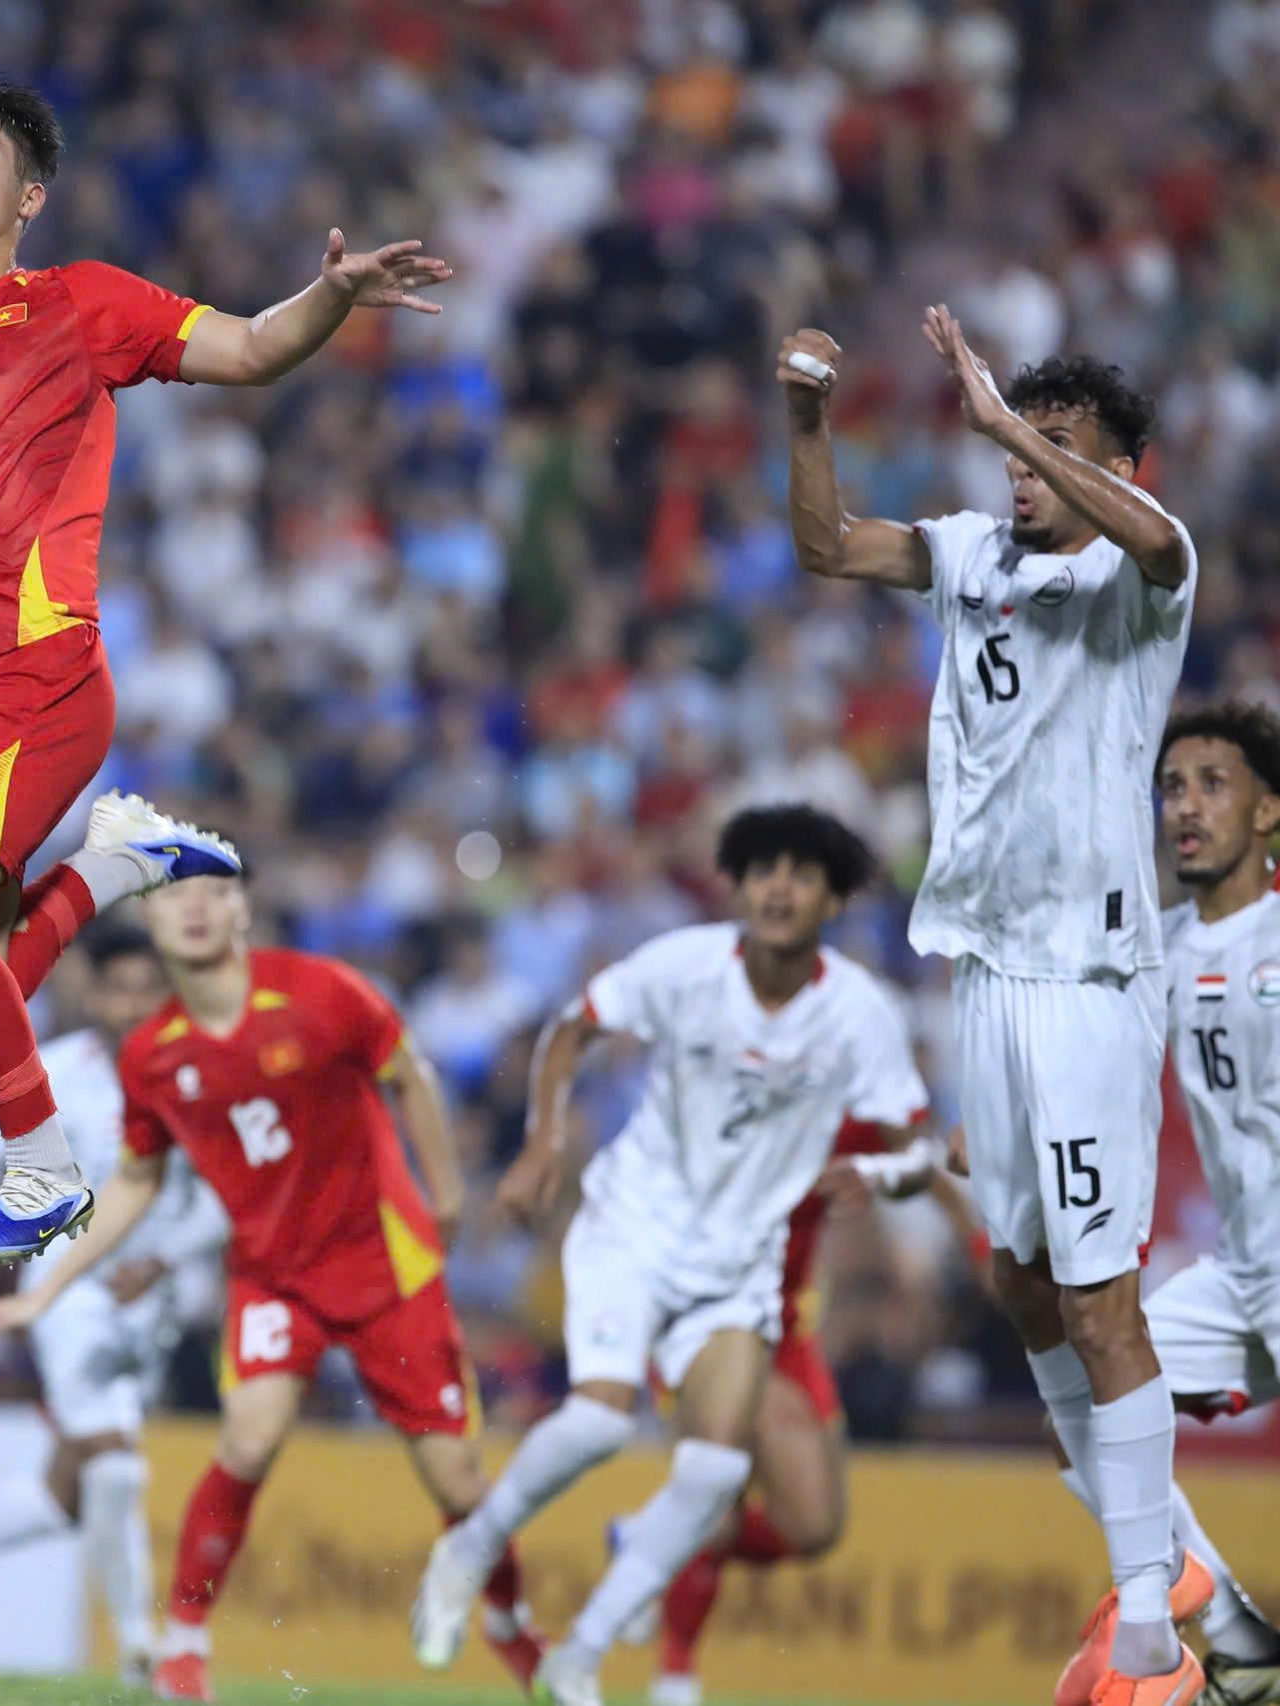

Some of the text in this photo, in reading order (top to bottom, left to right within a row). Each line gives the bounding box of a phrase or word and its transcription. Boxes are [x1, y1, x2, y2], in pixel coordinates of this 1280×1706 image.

[976, 633, 1019, 703] 15
[1191, 1027, 1237, 1091] 16
[229, 1097, 293, 1166] 12
[1048, 1137, 1101, 1209] 15
[239, 1300, 292, 1362] 12
